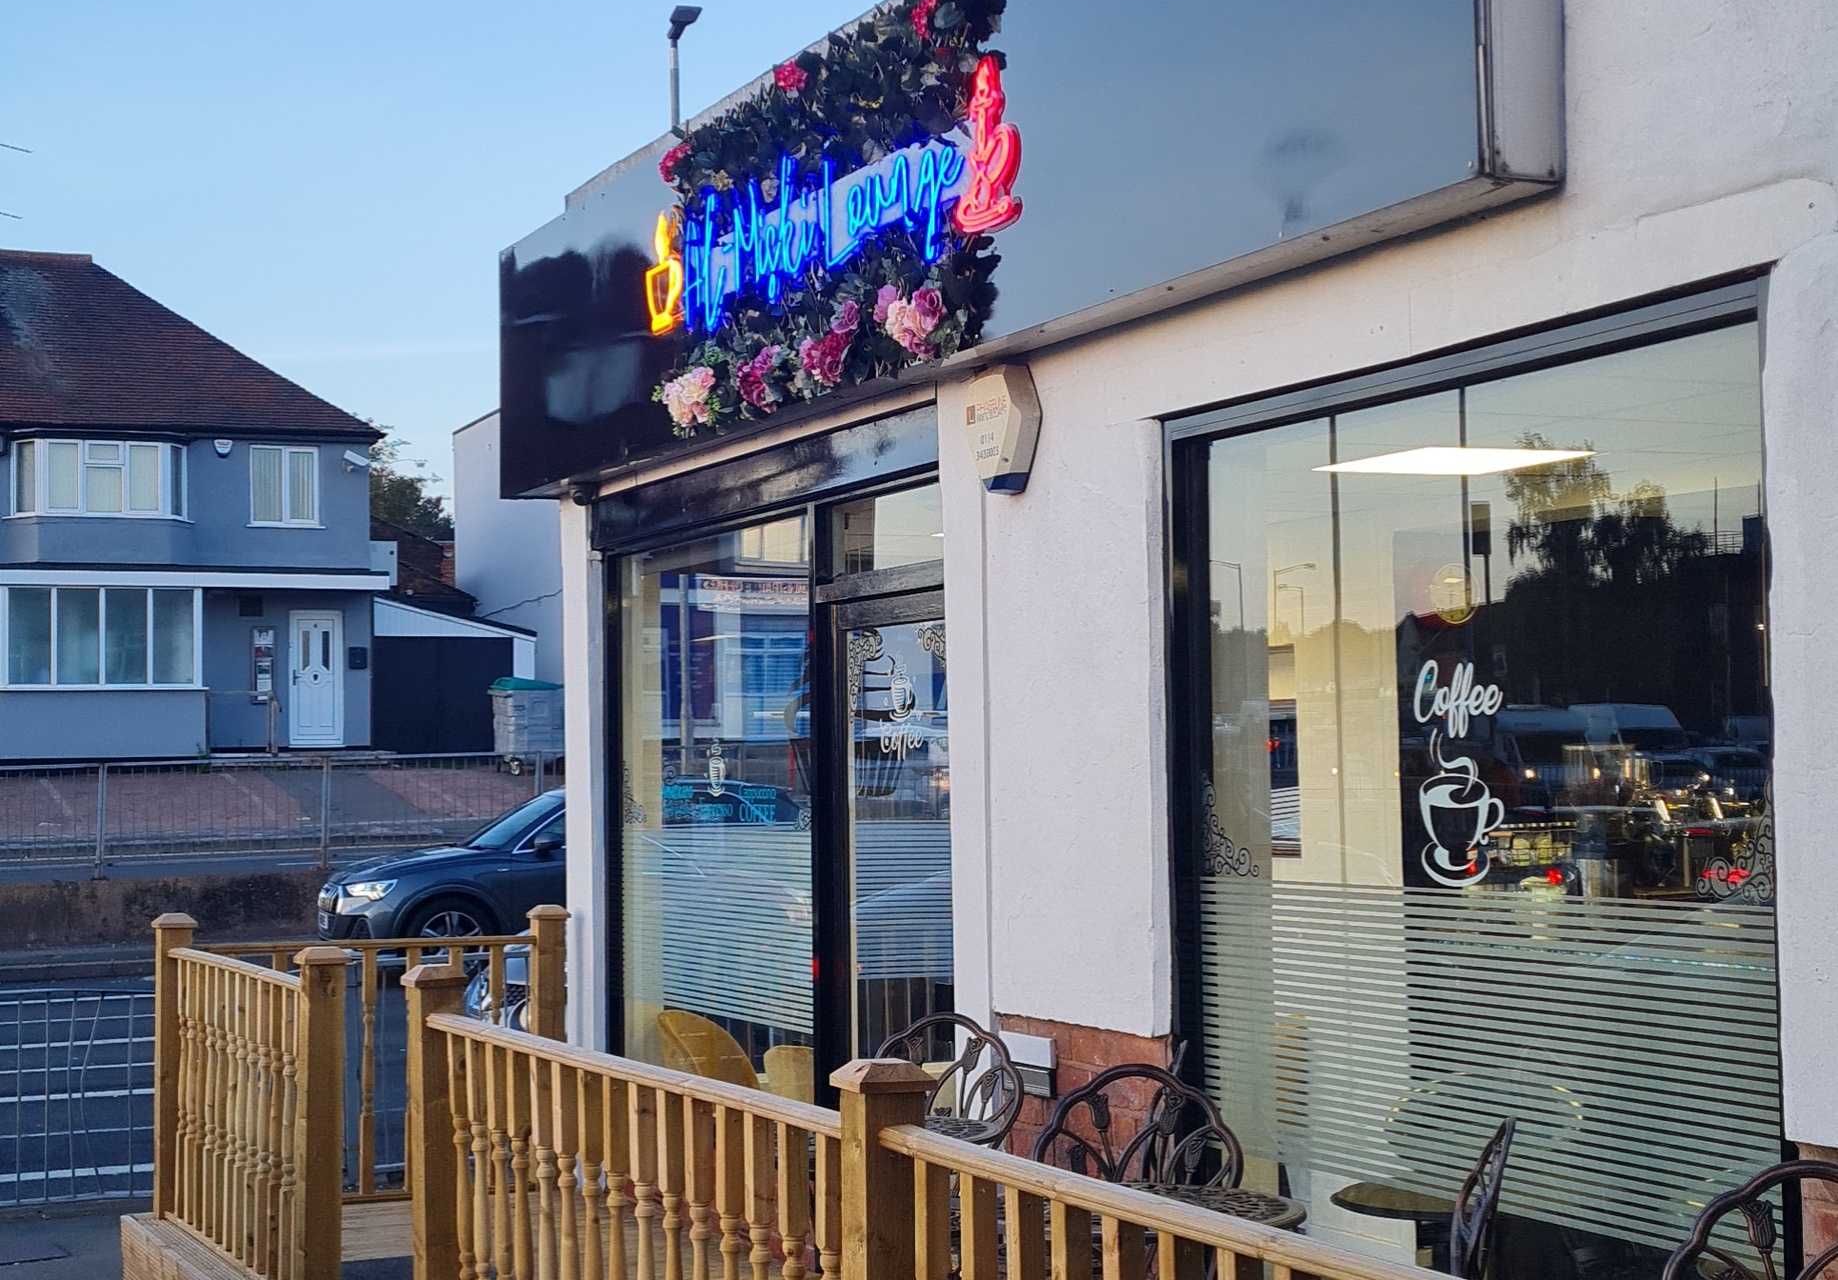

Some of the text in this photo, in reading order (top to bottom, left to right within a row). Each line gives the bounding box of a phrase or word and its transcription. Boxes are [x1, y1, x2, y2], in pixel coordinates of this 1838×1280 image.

[823, 146, 965, 267] Lounge
[981, 432, 994, 445] 0114
[1414, 660, 1503, 738] Coffee
[880, 719, 924, 760] Coffee
